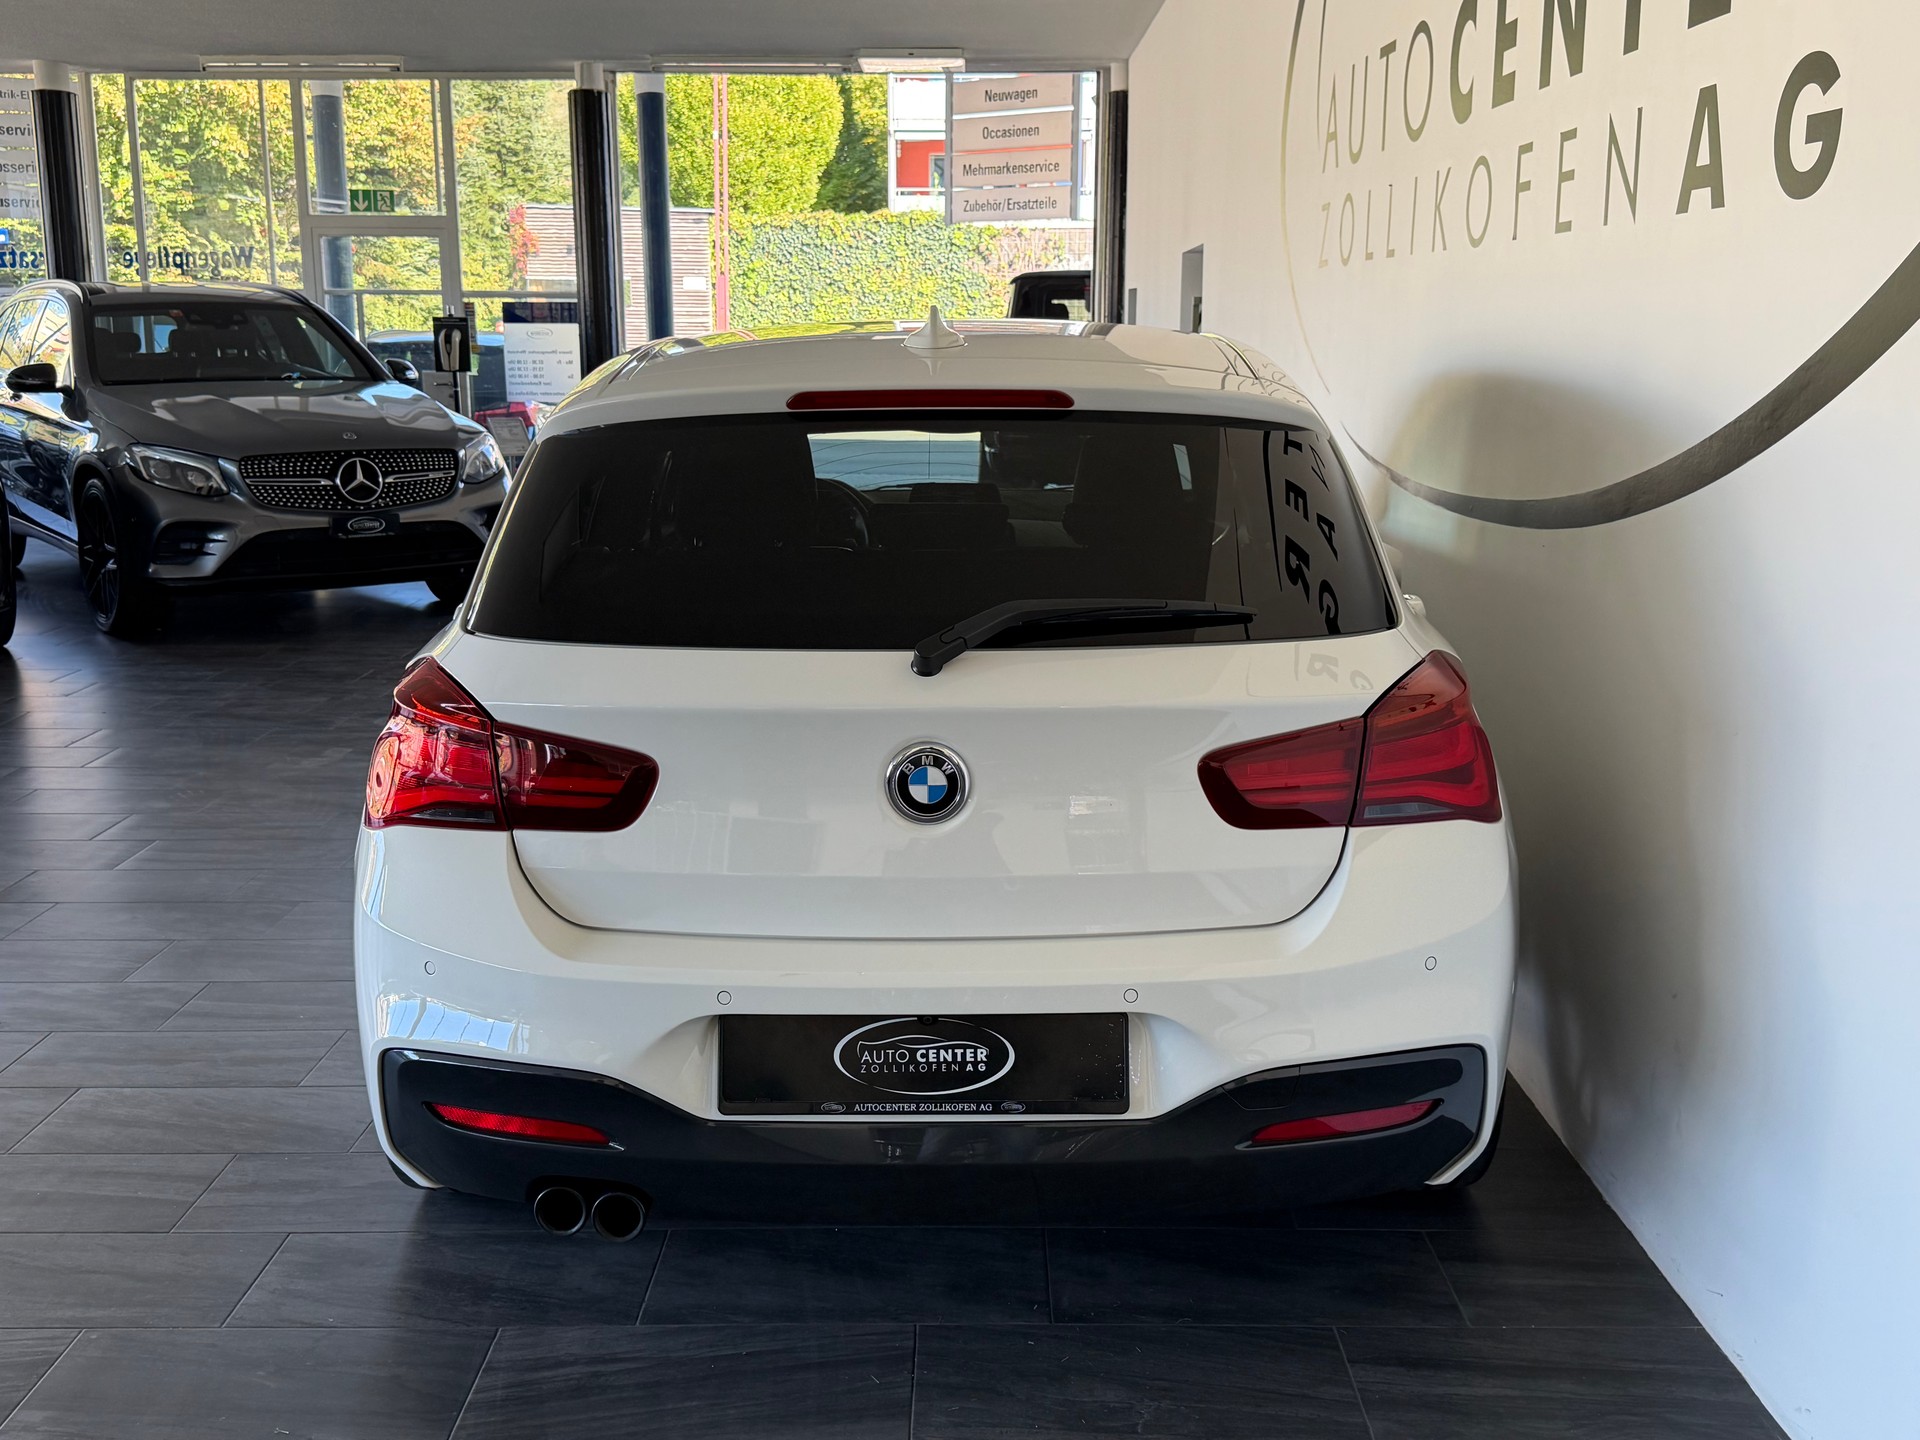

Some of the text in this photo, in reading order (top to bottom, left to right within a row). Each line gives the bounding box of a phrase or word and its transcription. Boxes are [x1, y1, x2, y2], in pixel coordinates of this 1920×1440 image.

[984, 88, 1038, 103] Neuwagen
[1322, 19, 1434, 174] AUTO
[982, 125, 1040, 140] Occasionen
[1318, 49, 1843, 269] ZOLLIKOFEN AG
[962, 160, 1060, 177] Mehrmarkenservice
[963, 197, 1057, 213] Zubehör/Ersatzteile
[902, 755, 954, 775] BMW
[861, 1049, 987, 1063] AUTO CENTER
[861, 1063, 986, 1073] ZOLLIKOFEN AG
[854, 1103, 993, 1112] AUTOCENTER ZOLLIKOFEN AG
